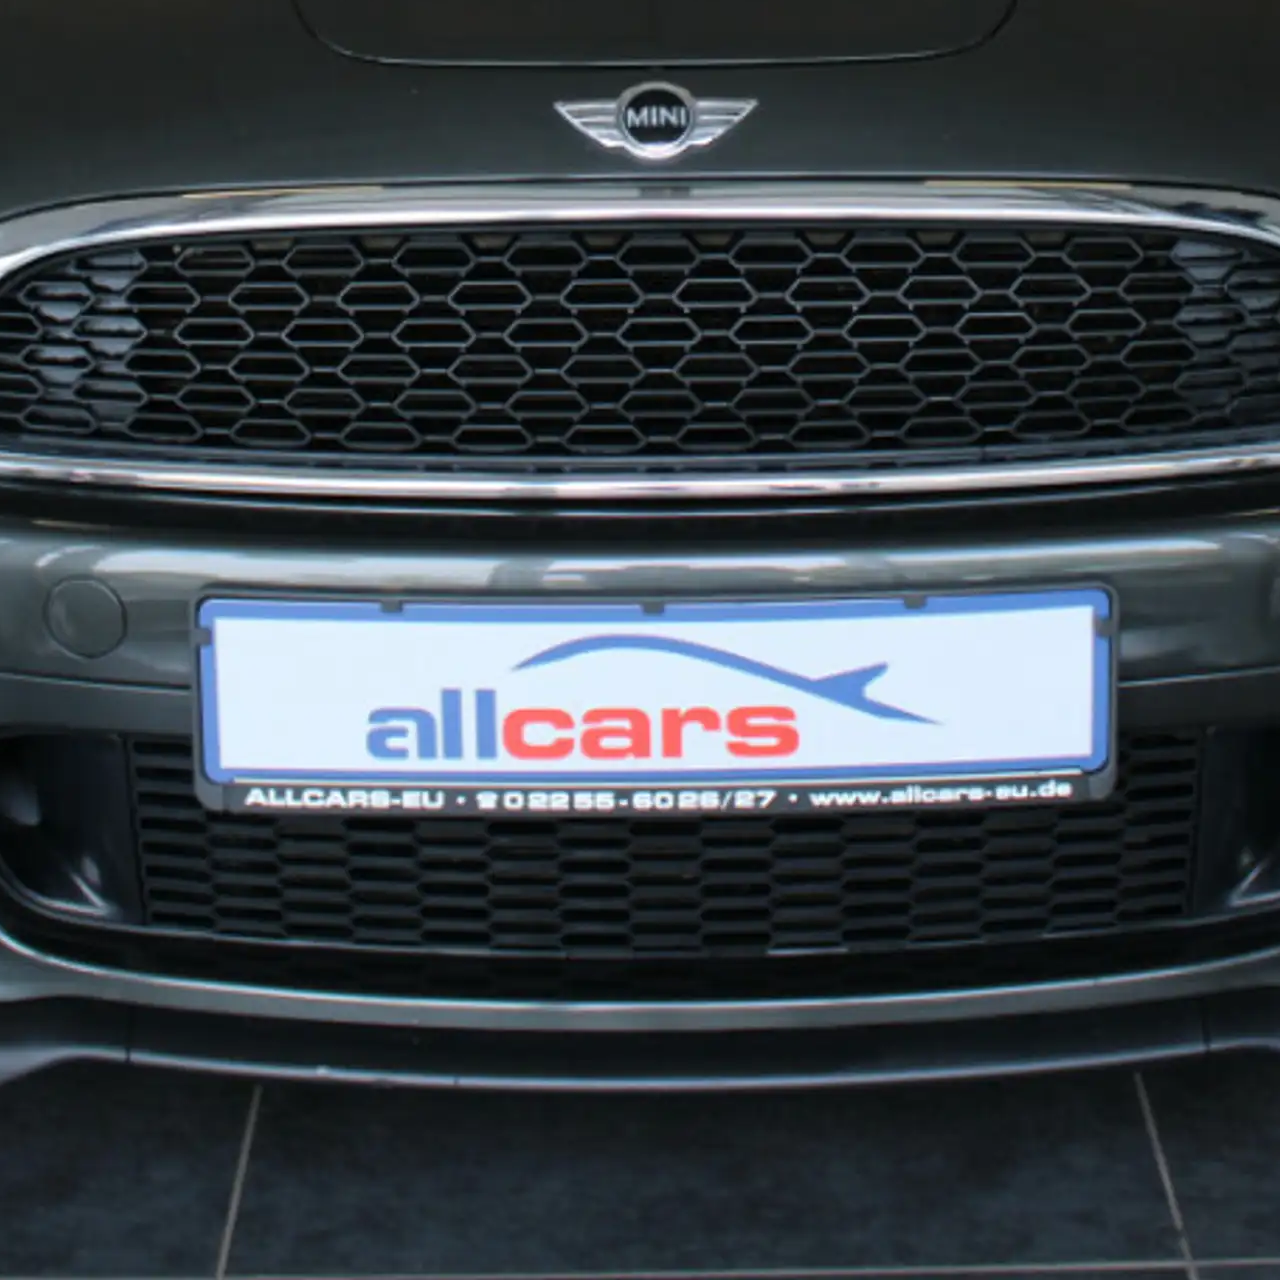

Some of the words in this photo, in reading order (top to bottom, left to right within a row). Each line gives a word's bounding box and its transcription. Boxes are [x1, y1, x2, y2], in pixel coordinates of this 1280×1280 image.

[627, 105, 686, 129] MINI
[365, 687, 801, 761] allcars
[244, 787, 446, 810] ALLCARS-EU
[809, 778, 1073, 807] www.allcars-eu.de
